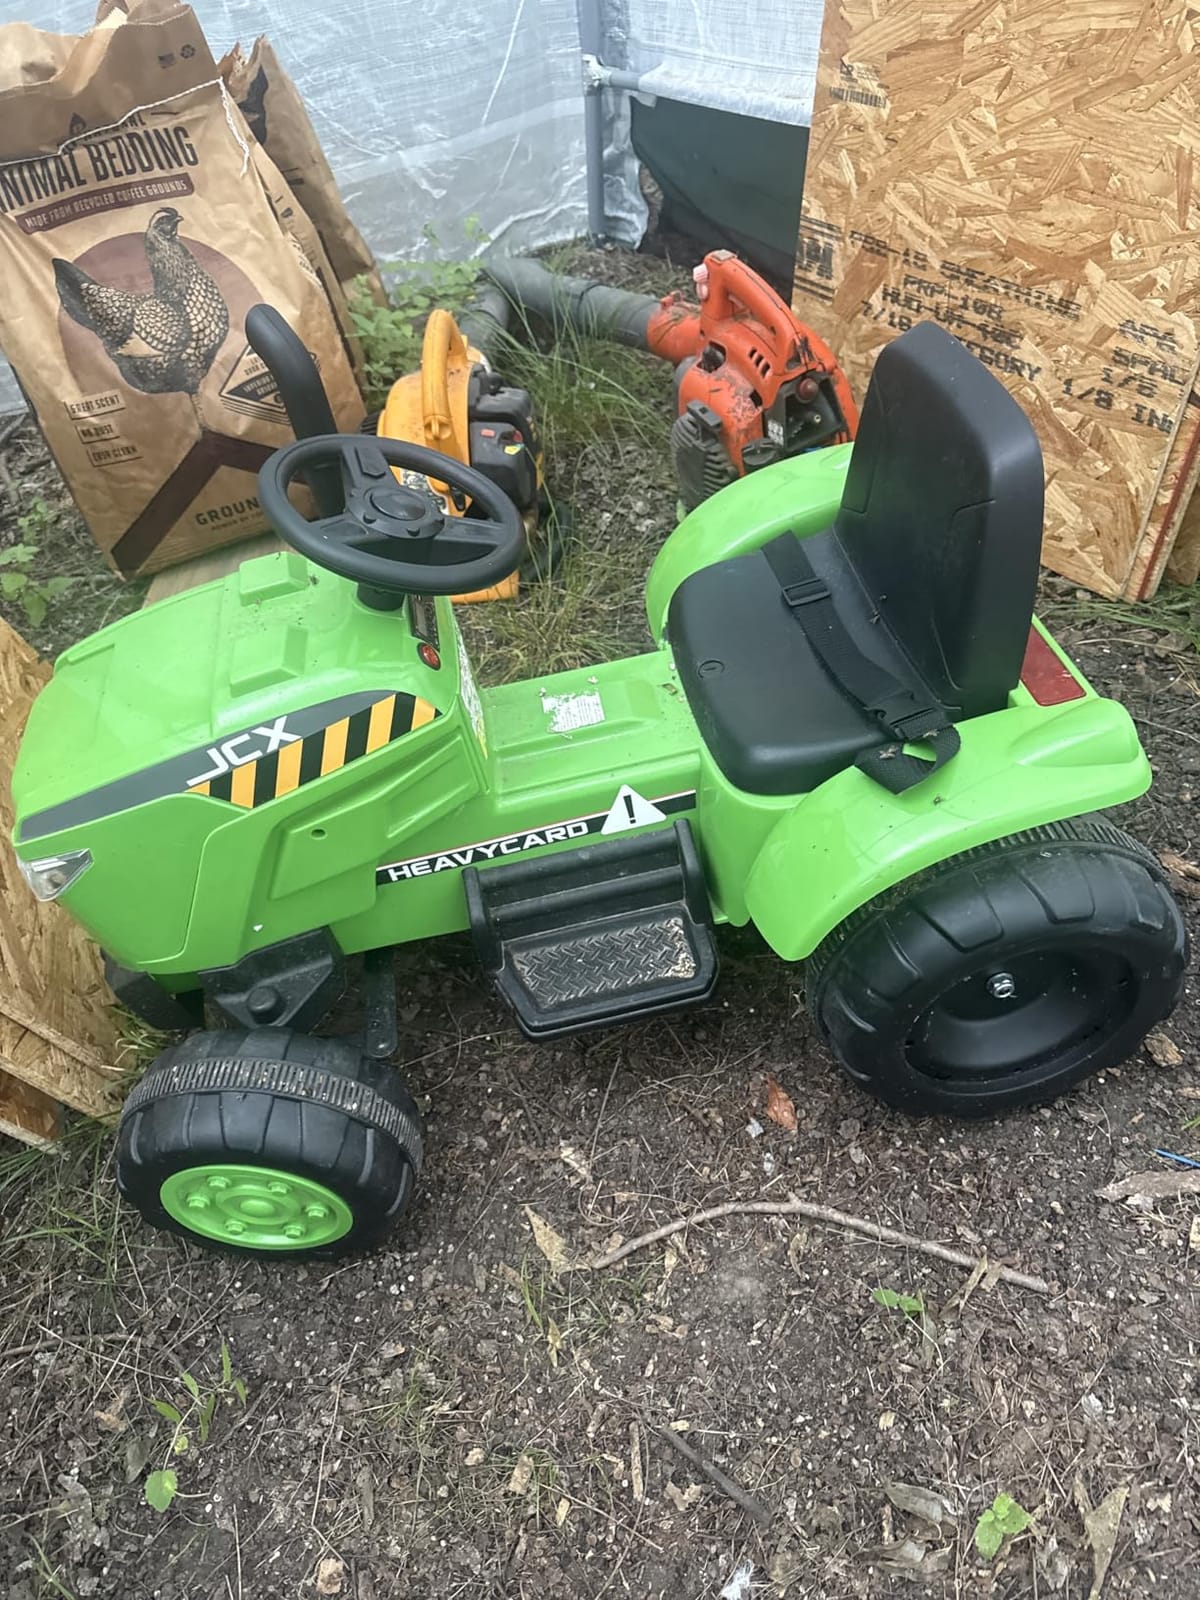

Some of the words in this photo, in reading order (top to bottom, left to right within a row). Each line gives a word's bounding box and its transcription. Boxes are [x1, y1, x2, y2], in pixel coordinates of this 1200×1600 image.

[84, 126, 199, 182] BEDDING
[49, 204, 74, 221] FROM
[73, 196, 115, 213] RECYCLED
[115, 186, 149, 202] COFFEE
[147, 179, 189, 196] GROUNDS
[95, 394, 120, 409] SCENT
[1062, 378, 1114, 410] 1/8
[195, 497, 260, 525] GROUN
[186, 715, 302, 786] JCX
[387, 821, 588, 882] HEAVYCARD
